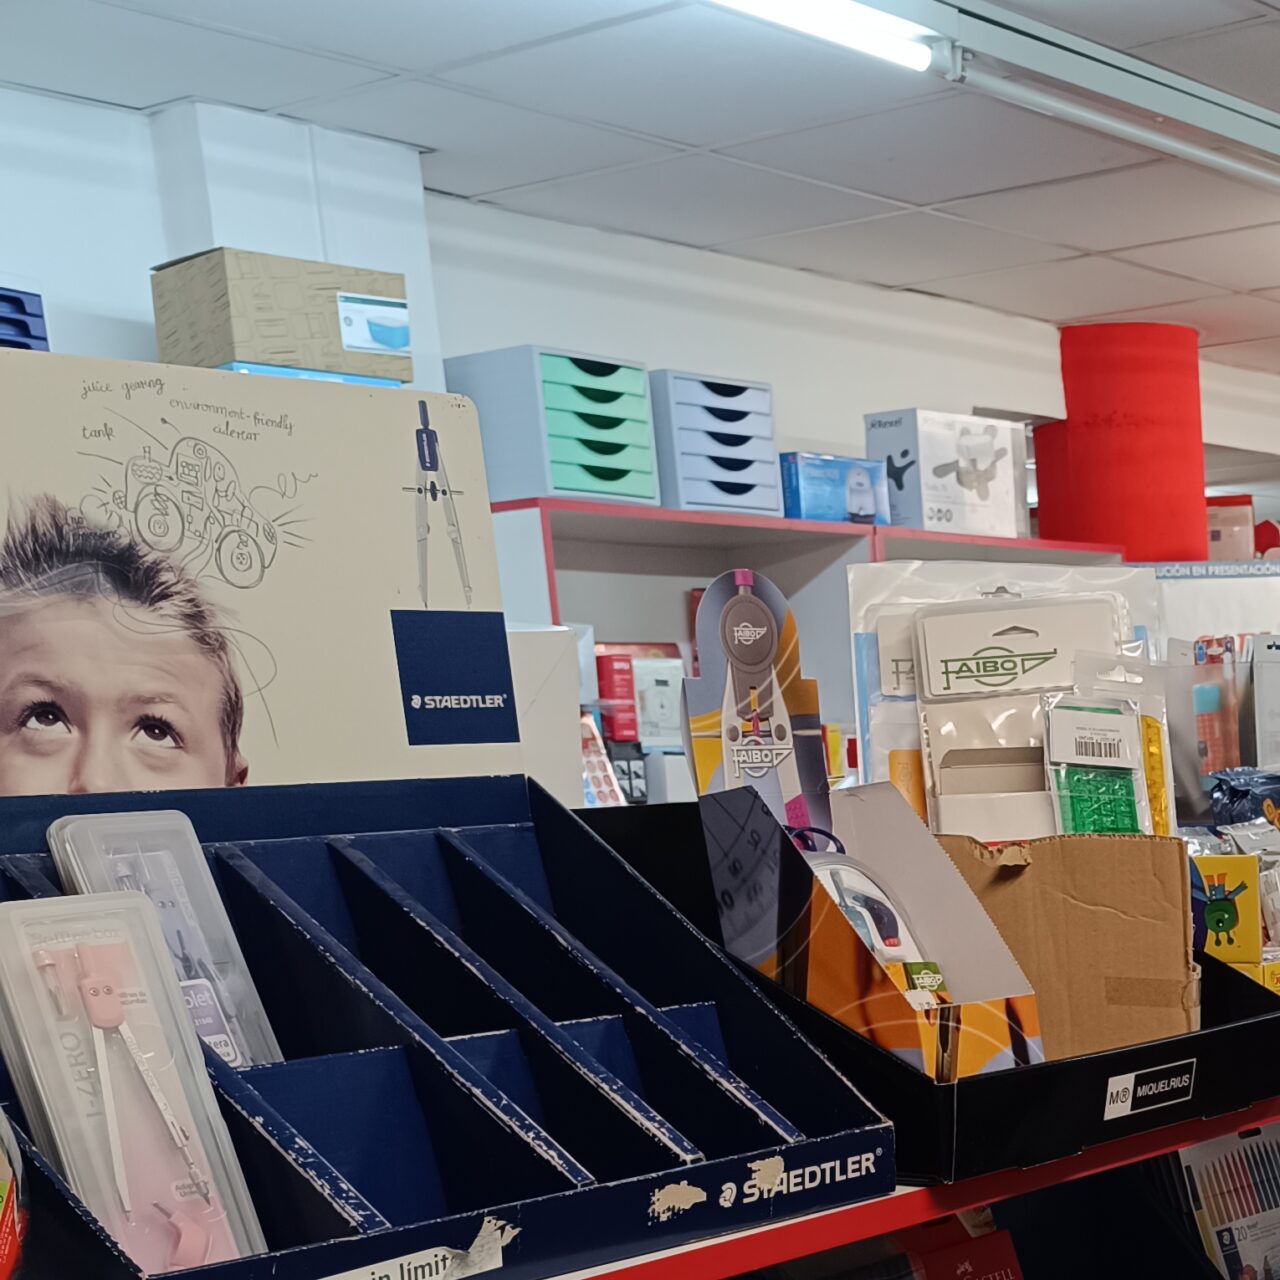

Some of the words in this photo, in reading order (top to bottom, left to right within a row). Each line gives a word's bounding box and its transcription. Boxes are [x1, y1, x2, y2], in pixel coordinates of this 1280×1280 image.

[1192, 566, 1207, 577] EN
[940, 648, 1057, 690] FAIBO
[424, 695, 504, 709] STAEDTLER
[731, 742, 793, 778] FAIBO
[1136, 1073, 1190, 1099] MIQUELRIUS
